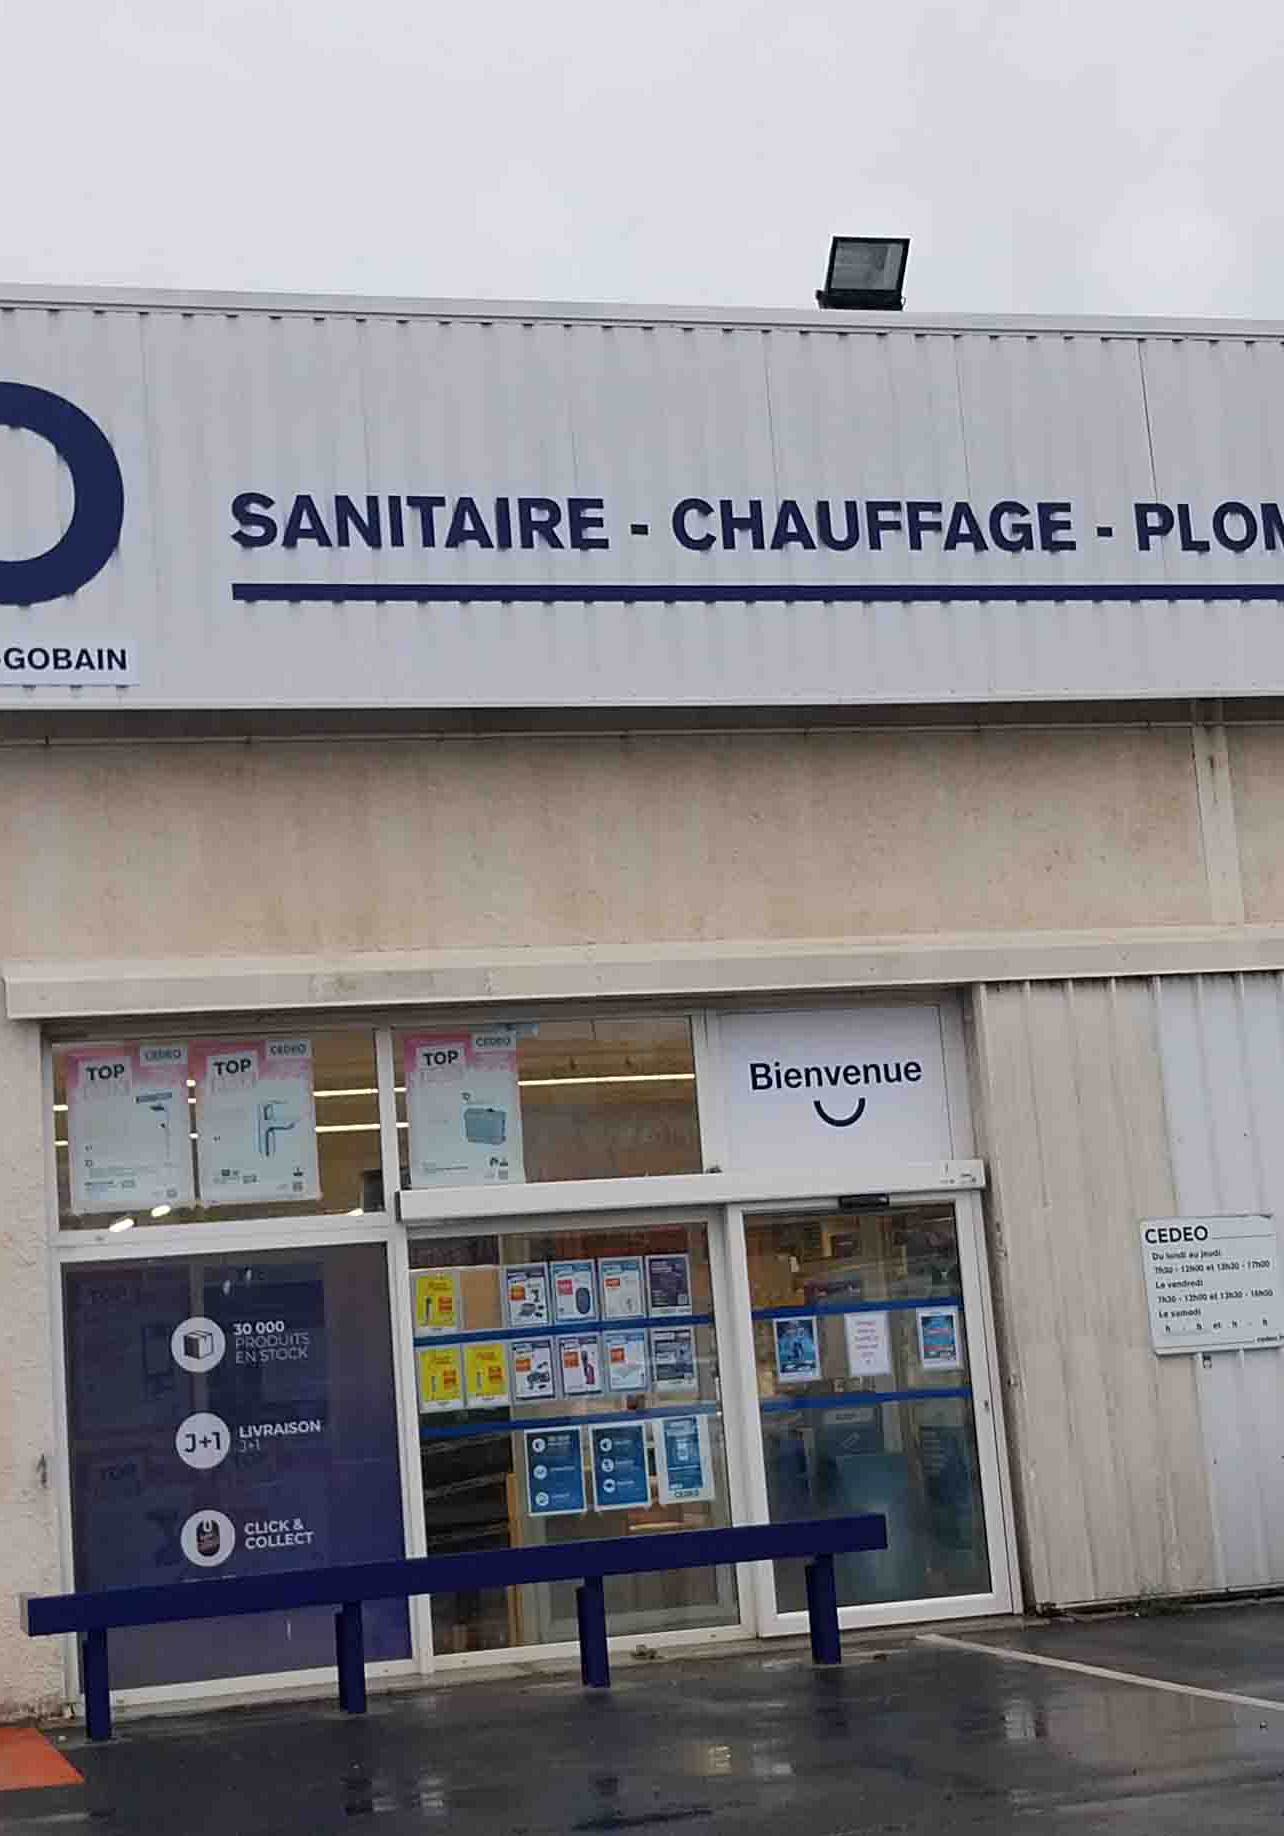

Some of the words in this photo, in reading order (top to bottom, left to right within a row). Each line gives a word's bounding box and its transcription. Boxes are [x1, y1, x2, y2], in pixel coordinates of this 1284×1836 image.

[231, 493, 610, 550] SANITAIRE
[630, 524, 650, 536] -
[672, 497, 1077, 552] CHAUFFAGE
[1096, 526, 1114, 537] -
[213, 1057, 252, 1076] TOP
[422, 1050, 459, 1067] TOP
[86, 1063, 125, 1081] TOP
[749, 1060, 922, 1091] Bienvenue
[1145, 1225, 1208, 1244] CEDEO
[1155, 1281, 1165, 1289] Le
[1168, 1279, 1203, 1288] vendredi
[233, 1323, 252, 1336] 30
[255, 1320, 285, 1334] 000
[235, 1332, 310, 1350] PRODUITS
[235, 1351, 257, 1364] EN
[259, 1346, 309, 1362] STOCK
[239, 1420, 322, 1438] LIVRAISON
[184, 1432, 221, 1453] J+1
[244, 1519, 290, 1535] CLICK
[291, 1518, 305, 1531] &
[244, 1531, 314, 1549] COLLECT
